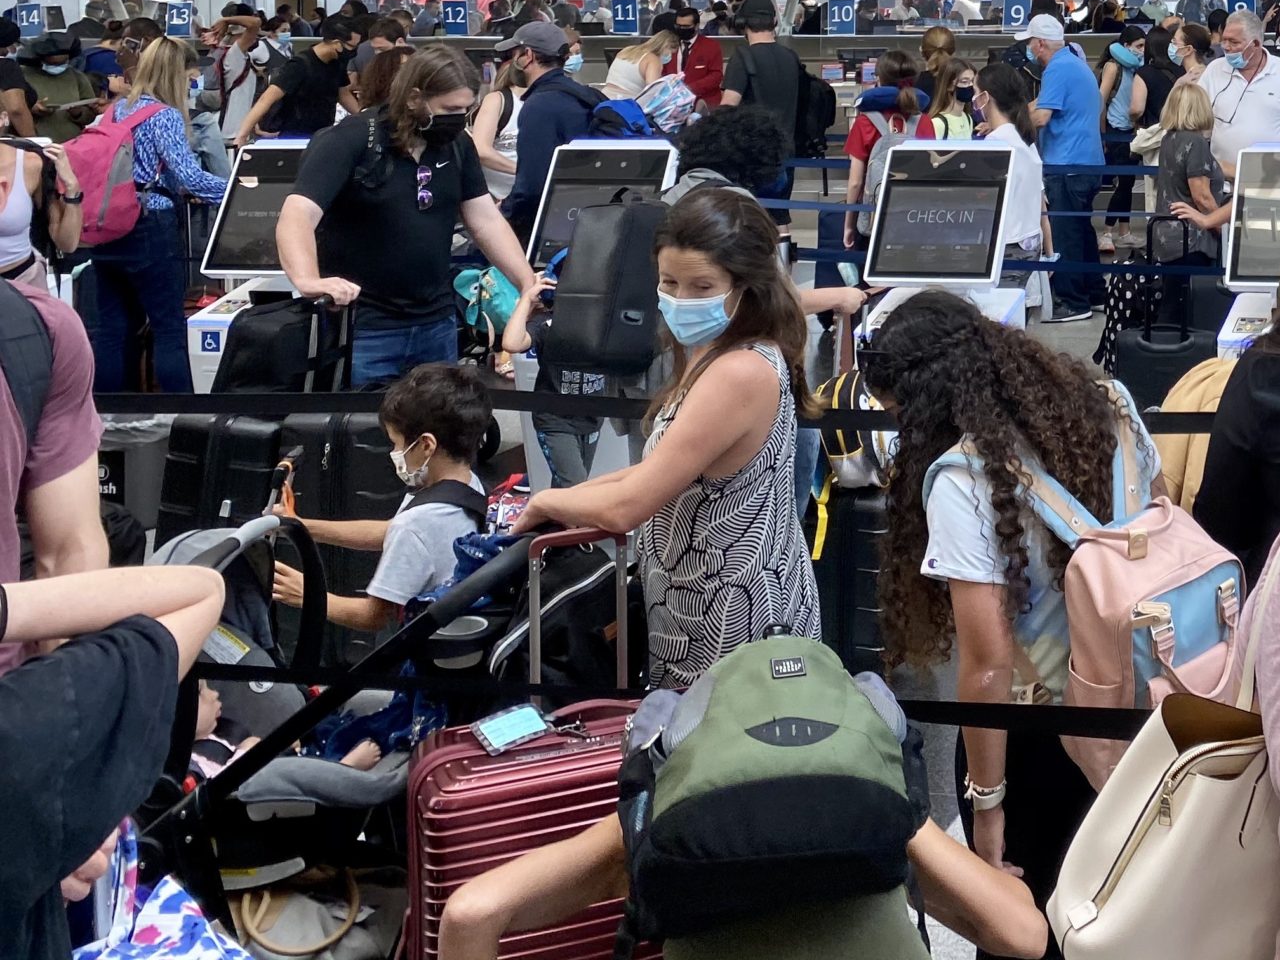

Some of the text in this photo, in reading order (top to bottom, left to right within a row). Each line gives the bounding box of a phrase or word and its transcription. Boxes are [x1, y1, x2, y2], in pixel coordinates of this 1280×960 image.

[20, 9, 39, 26] 14
[170, 8, 189, 25] 13
[445, 7, 466, 23] 12
[614, 4, 635, 20] 11
[831, 5, 853, 22] 10
[1010, 5, 1025, 26] 9
[907, 209, 975, 223] CHECK IN
[562, 370, 580, 383] BE
[561, 382, 580, 395] BE
